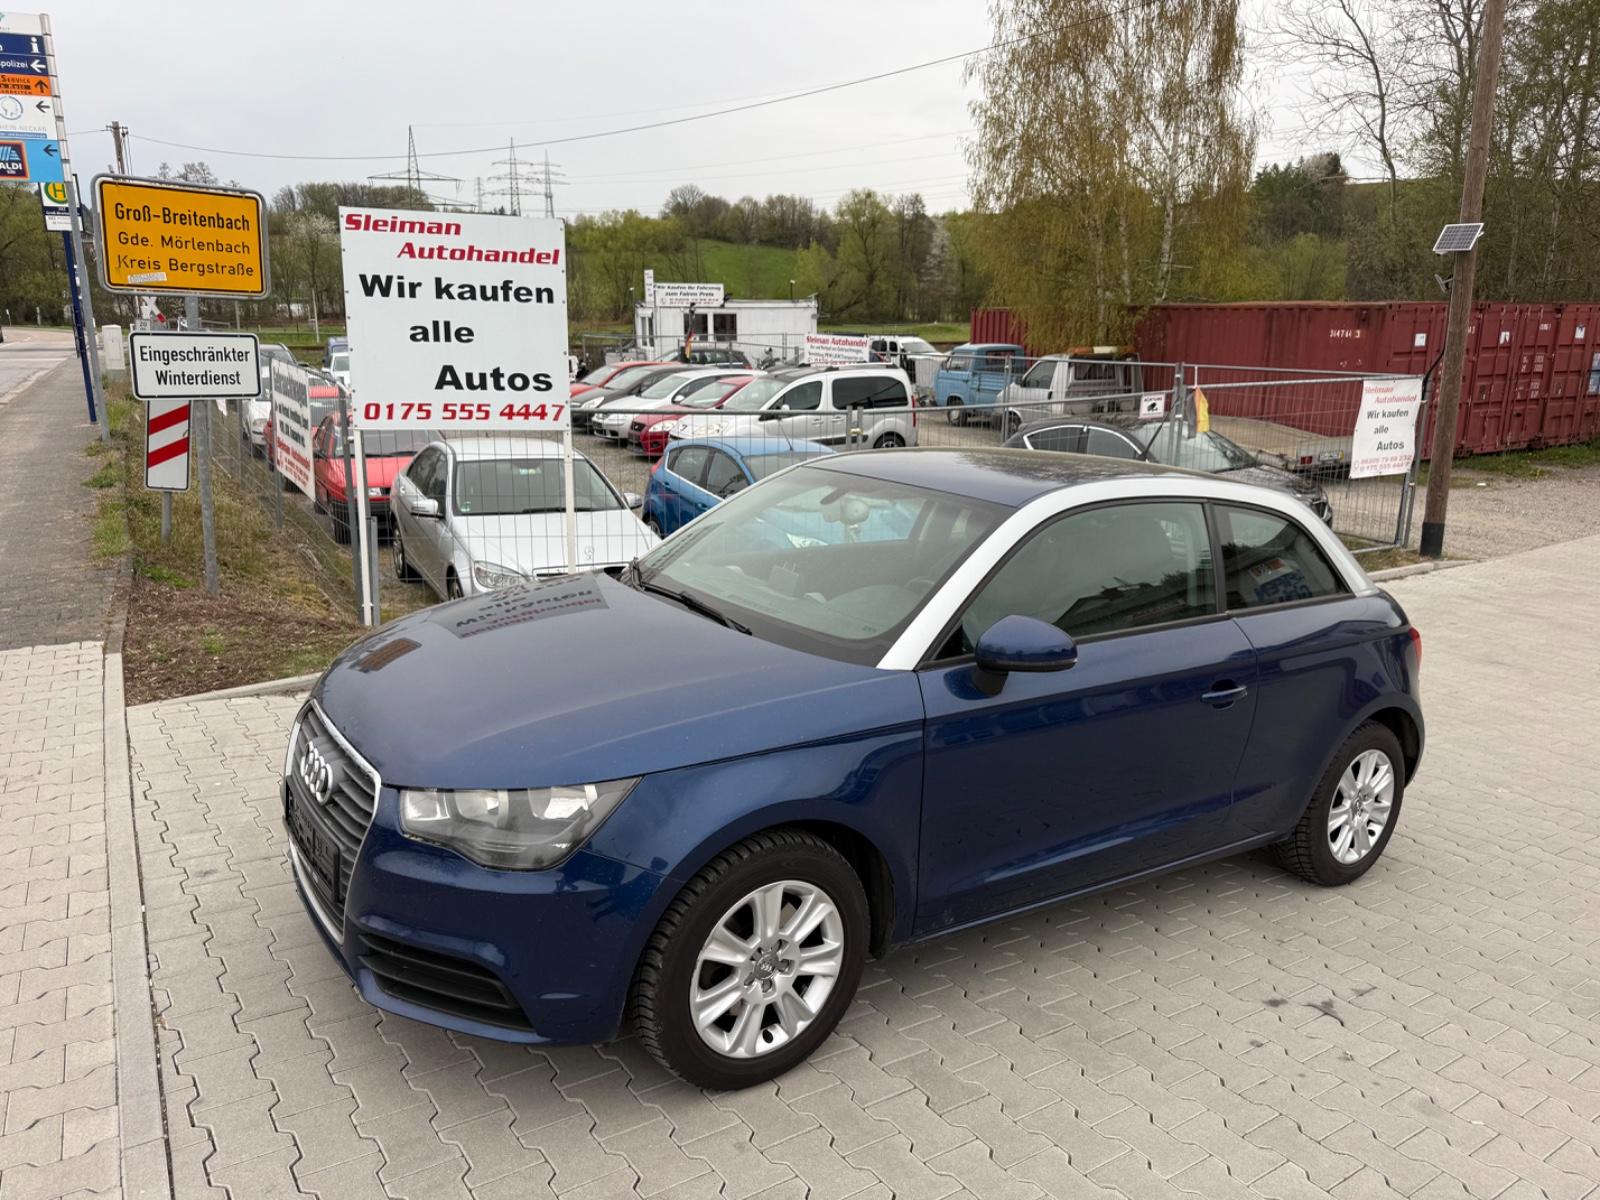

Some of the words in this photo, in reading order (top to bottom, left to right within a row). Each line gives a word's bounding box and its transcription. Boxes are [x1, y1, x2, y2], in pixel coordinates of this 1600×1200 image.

[0, 59, 28, 69] polizei
[114, 202, 250, 231] Groß-Breitenbach
[344, 213, 461, 236] Sleiman
[118, 231, 153, 247] Gde.
[161, 235, 250, 254] Mörlenbach
[397, 242, 560, 265] Autohandel
[117, 254, 161, 270] Kreis
[169, 258, 254, 277] Bergstraße
[359, 273, 422, 298] Wir
[435, 276, 554, 304] kaufen
[409, 320, 475, 343] alle
[140, 345, 250, 366] Eingeschränkter
[155, 370, 241, 385] Winterdienst
[434, 364, 553, 392] Autos
[364, 402, 432, 420] 0175
[442, 403, 491, 420] 555
[499, 403, 565, 421] 4447
[1367, 410, 1379, 419] Wir
[1382, 408, 1409, 418] kaufen
[1374, 425, 1389, 435] alle
[1376, 441, 1404, 451] Autos
